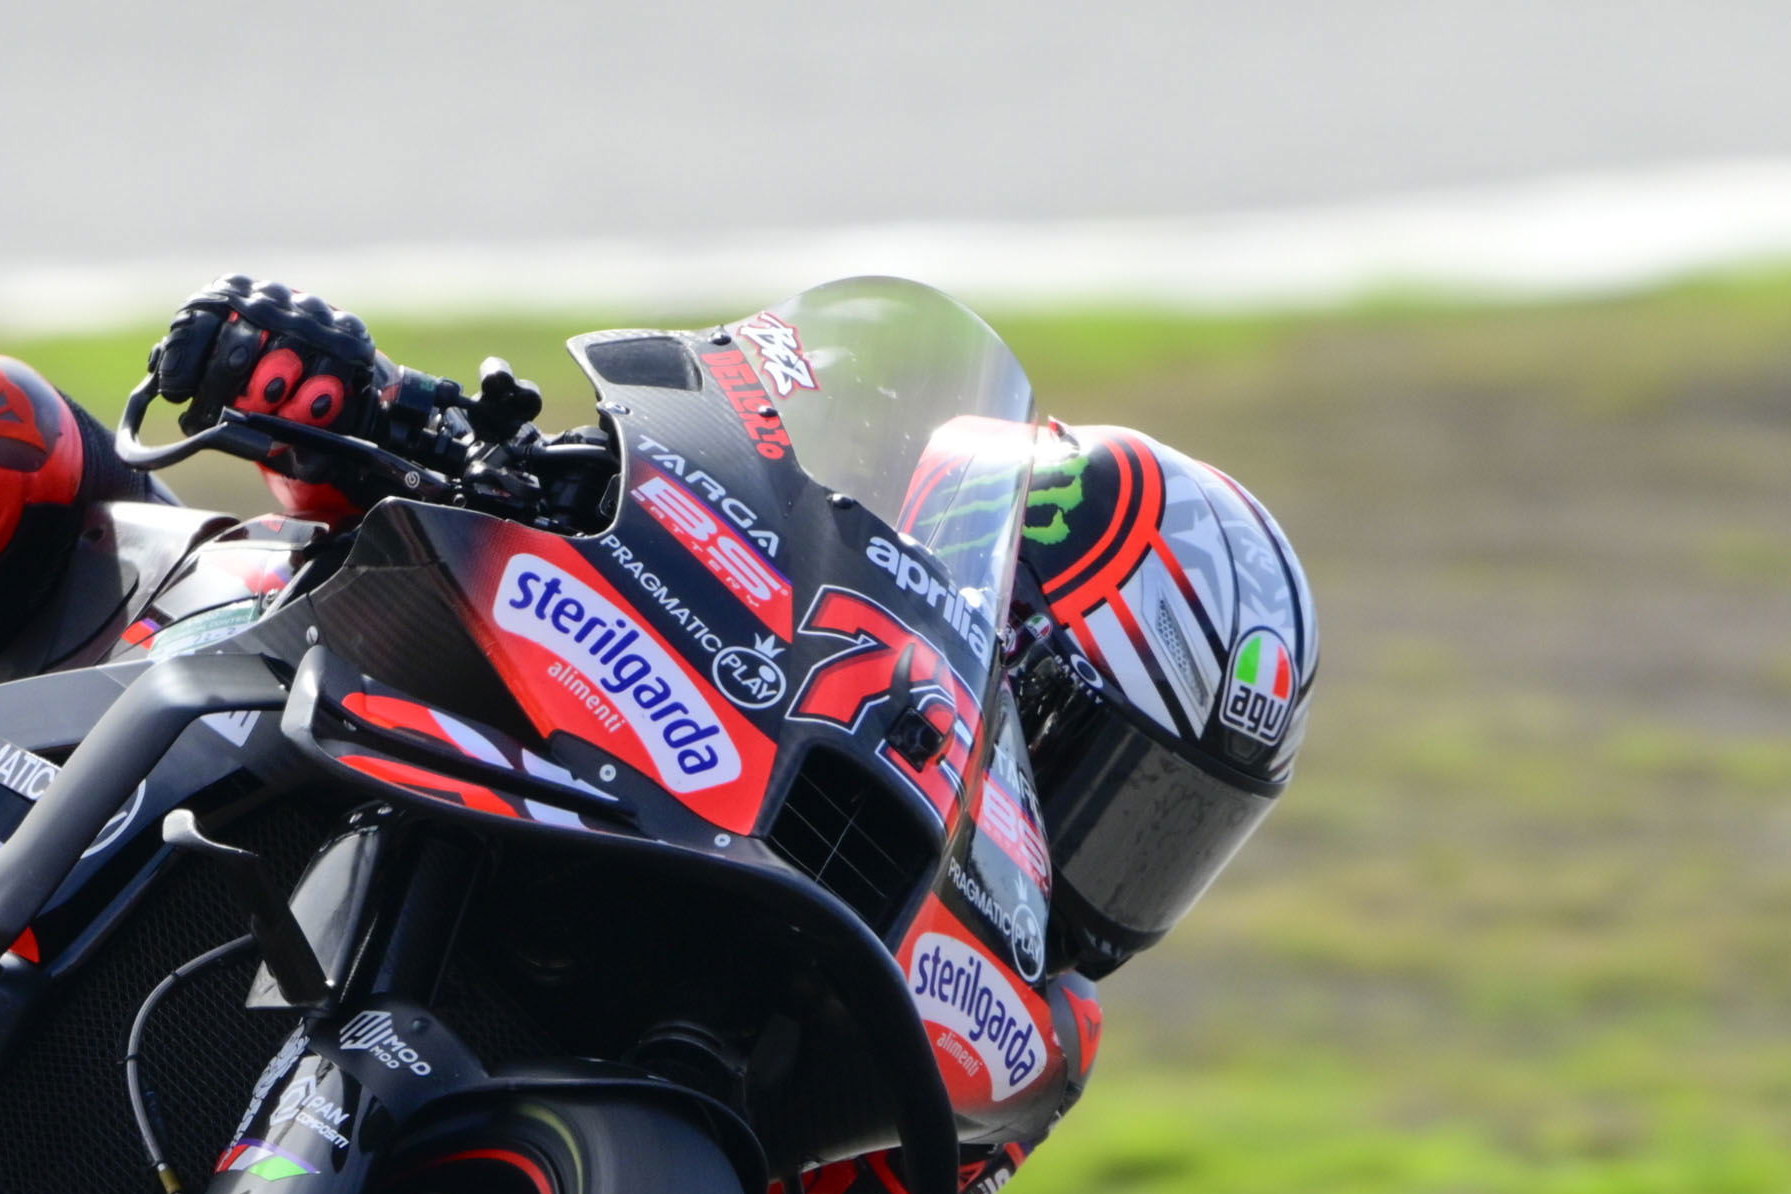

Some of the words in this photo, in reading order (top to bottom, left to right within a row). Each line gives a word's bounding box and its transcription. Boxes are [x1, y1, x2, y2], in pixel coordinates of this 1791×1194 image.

[637, 434, 779, 557] TARGA
[637, 476, 781, 600] BS
[600, 534, 722, 652] PRAGMATIC
[630, 489, 759, 607] BATTERY
[865, 536, 989, 672] aprilia
[509, 571, 720, 775] sterilgarda
[547, 662, 626, 733] alimenti
[721, 654, 777, 700] PLAY
[1055, 654, 1102, 704] OAKLEY
[947, 856, 1012, 936] PRAGMATIC
[369, 1045, 400, 1069] MOD
[383, 1034, 432, 1076] MOD
[915, 946, 1036, 1087] sterilgarda
[936, 1031, 982, 1077] alimenti
